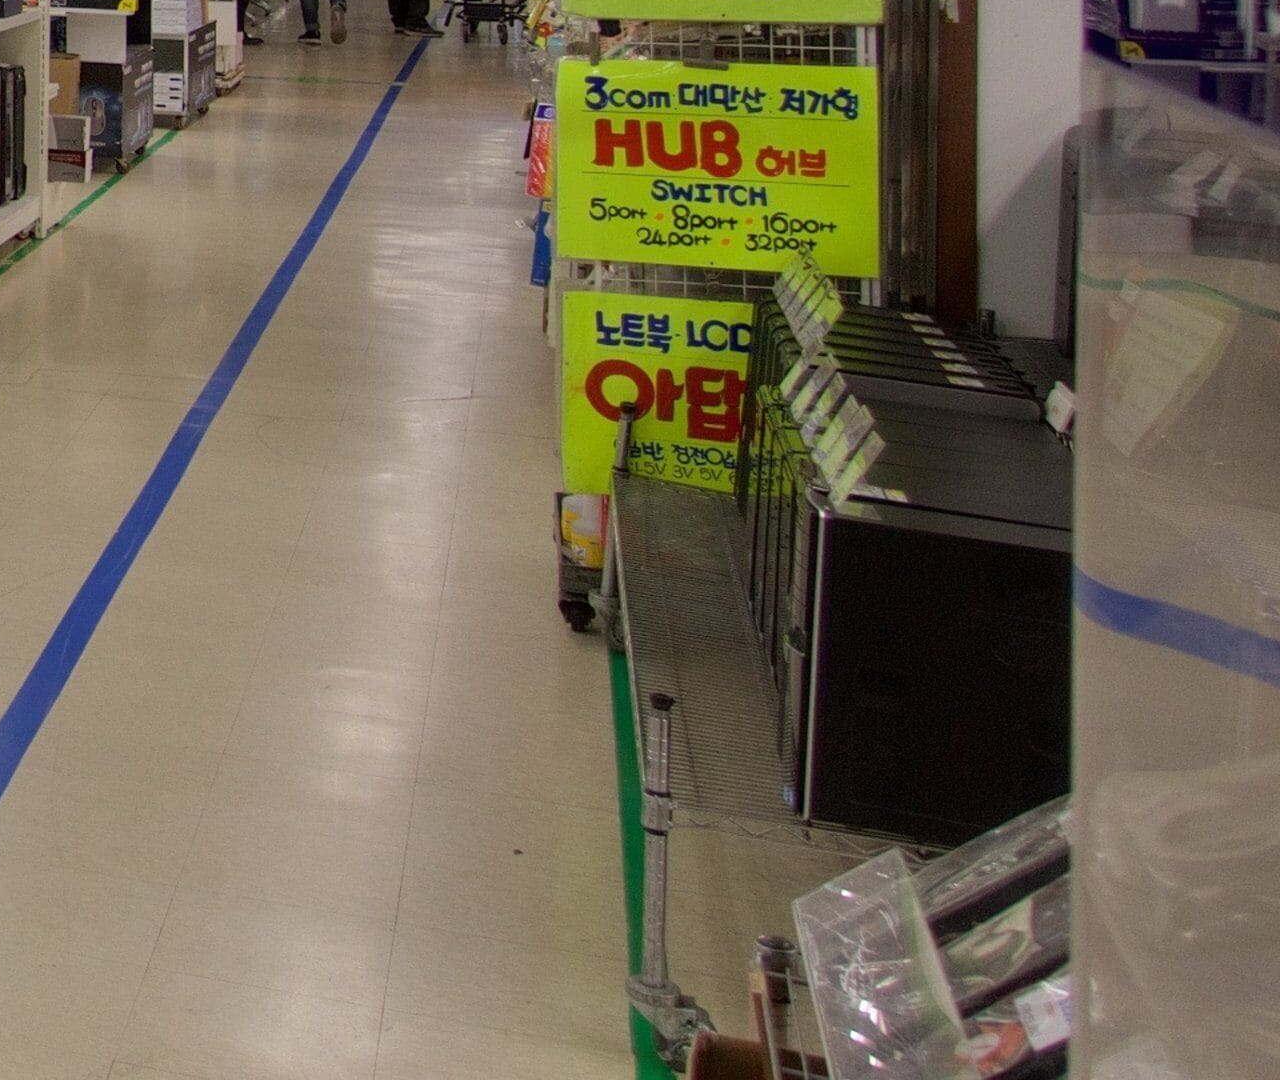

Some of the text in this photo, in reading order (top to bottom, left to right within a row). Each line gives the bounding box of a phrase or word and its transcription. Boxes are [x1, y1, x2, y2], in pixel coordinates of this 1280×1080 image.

[584, 76, 859, 120] 3com 대만산 저가형
[593, 118, 827, 178] HUB 허브
[651, 179, 768, 206] SWITCH
[589, 198, 838, 238] 5port 8port 16port
[638, 226, 712, 248] 24port
[596, 310, 671, 354] 노트북
